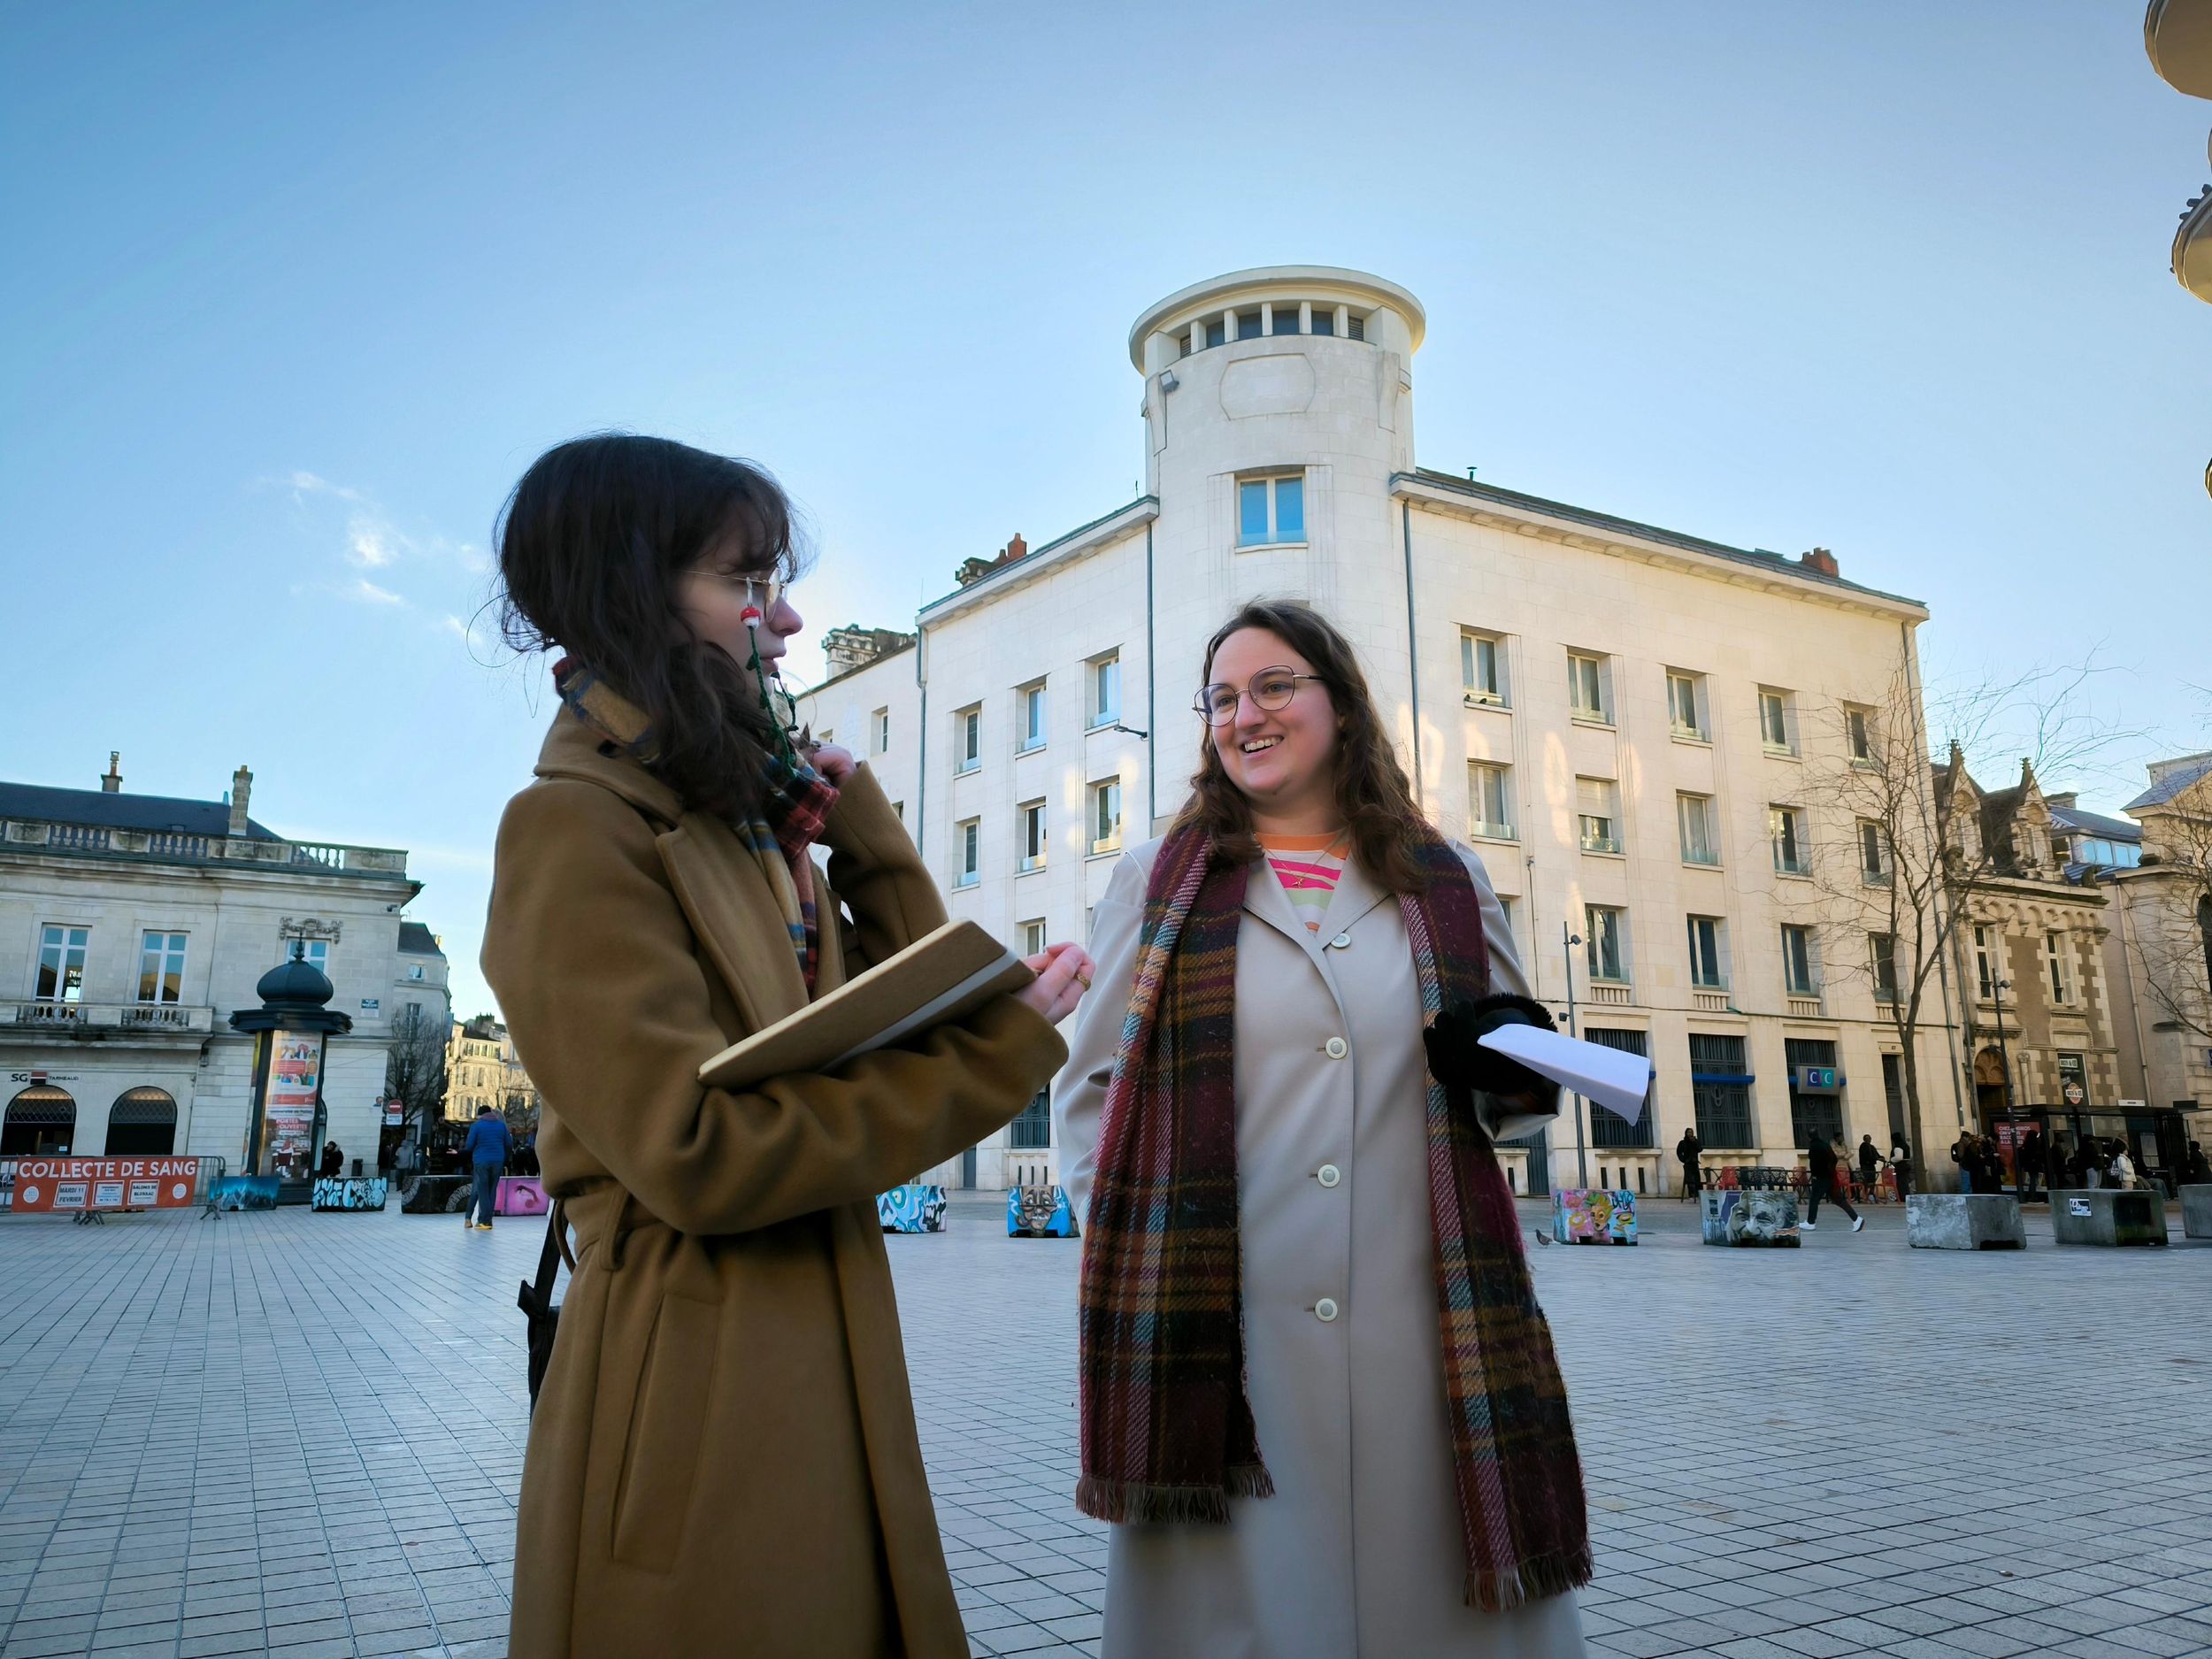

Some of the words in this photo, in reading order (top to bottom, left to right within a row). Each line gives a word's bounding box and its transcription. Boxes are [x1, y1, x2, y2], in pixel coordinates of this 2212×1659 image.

[11, 1073, 28, 1082] SG
[19, 1161, 114, 1178] COLLECTE
[121, 1161, 144, 1177] DE
[150, 1160, 196, 1176] SANG
